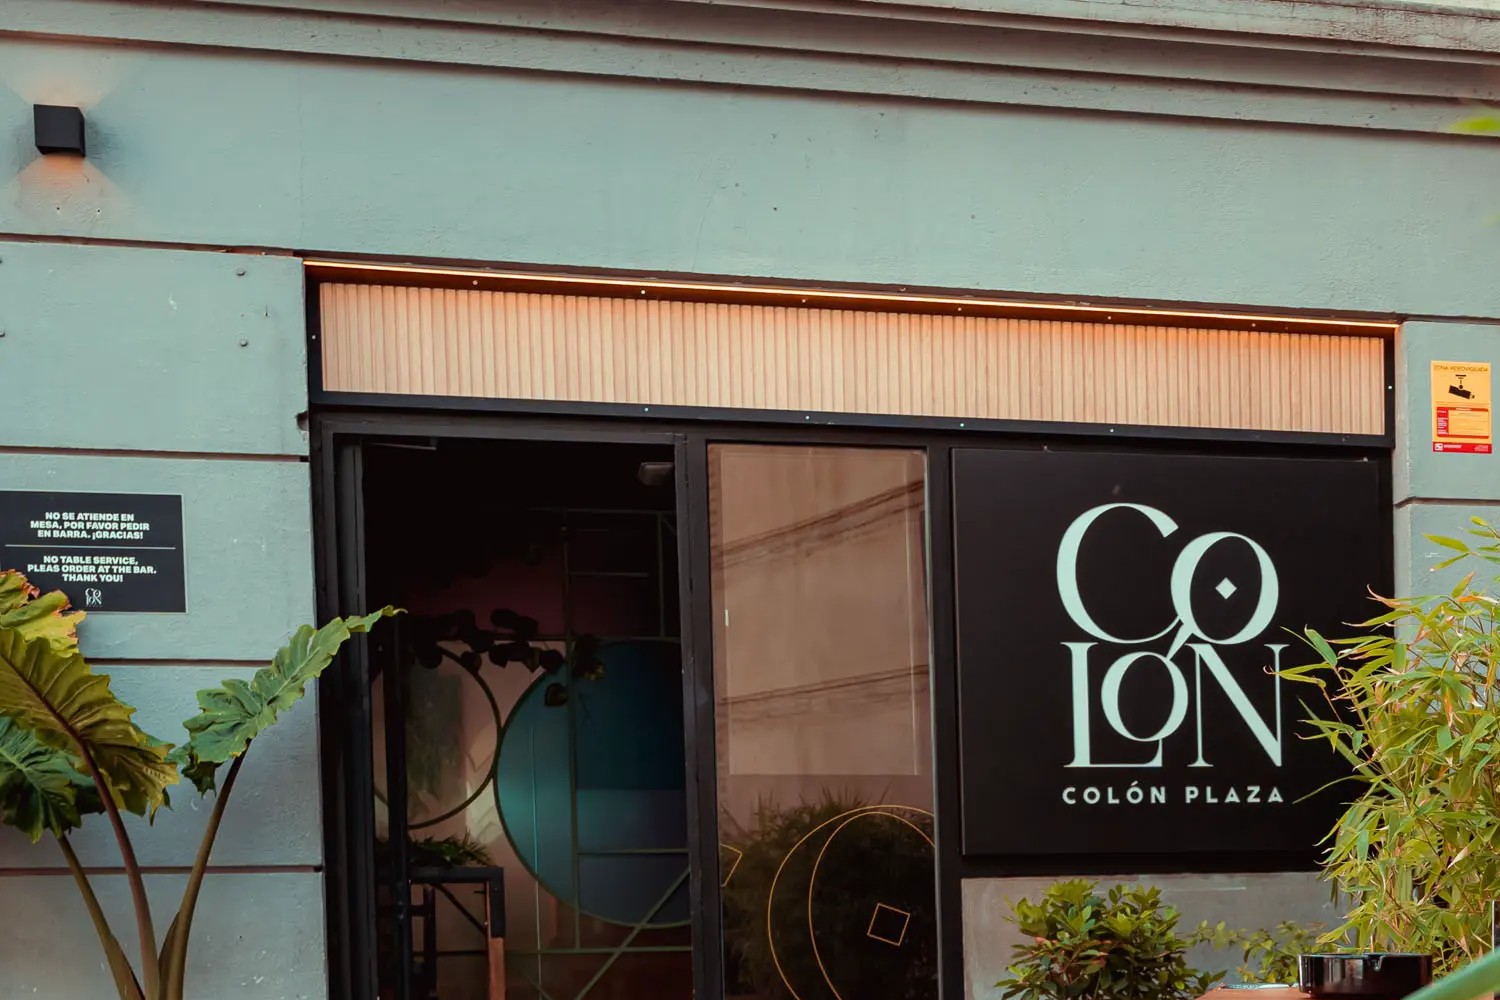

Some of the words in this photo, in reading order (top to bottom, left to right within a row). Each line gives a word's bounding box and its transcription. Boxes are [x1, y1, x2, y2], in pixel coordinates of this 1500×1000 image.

[45, 512, 61, 521] NO
[62, 512, 76, 521] SE
[76, 512, 119, 522] ATIENDE
[121, 513, 135, 522] EN
[30, 520, 63, 530] MESA,
[63, 521, 85, 530] POR
[86, 521, 119, 531] FAVOR
[120, 522, 150, 531] PEDIR
[37, 529, 51, 538] EN
[52, 530, 91, 539] BARRA.
[92, 530, 144, 540] ¡GRACIAS!
[43, 555, 59, 564] NO
[60, 556, 92, 565] TABLE
[93, 556, 139, 566] SERVICE,
[27, 564, 60, 573] PLEAS
[61, 565, 96, 574] ORDER
[97, 565, 111, 574] AT
[111, 565, 132, 574] THE
[133, 566, 157, 575] BAR.
[62, 573, 98, 582] THANK
[99, 574, 124, 583] YOU!
[1062, 781, 1166, 805] COLÓN
[1185, 786, 1284, 804] PLAZA
